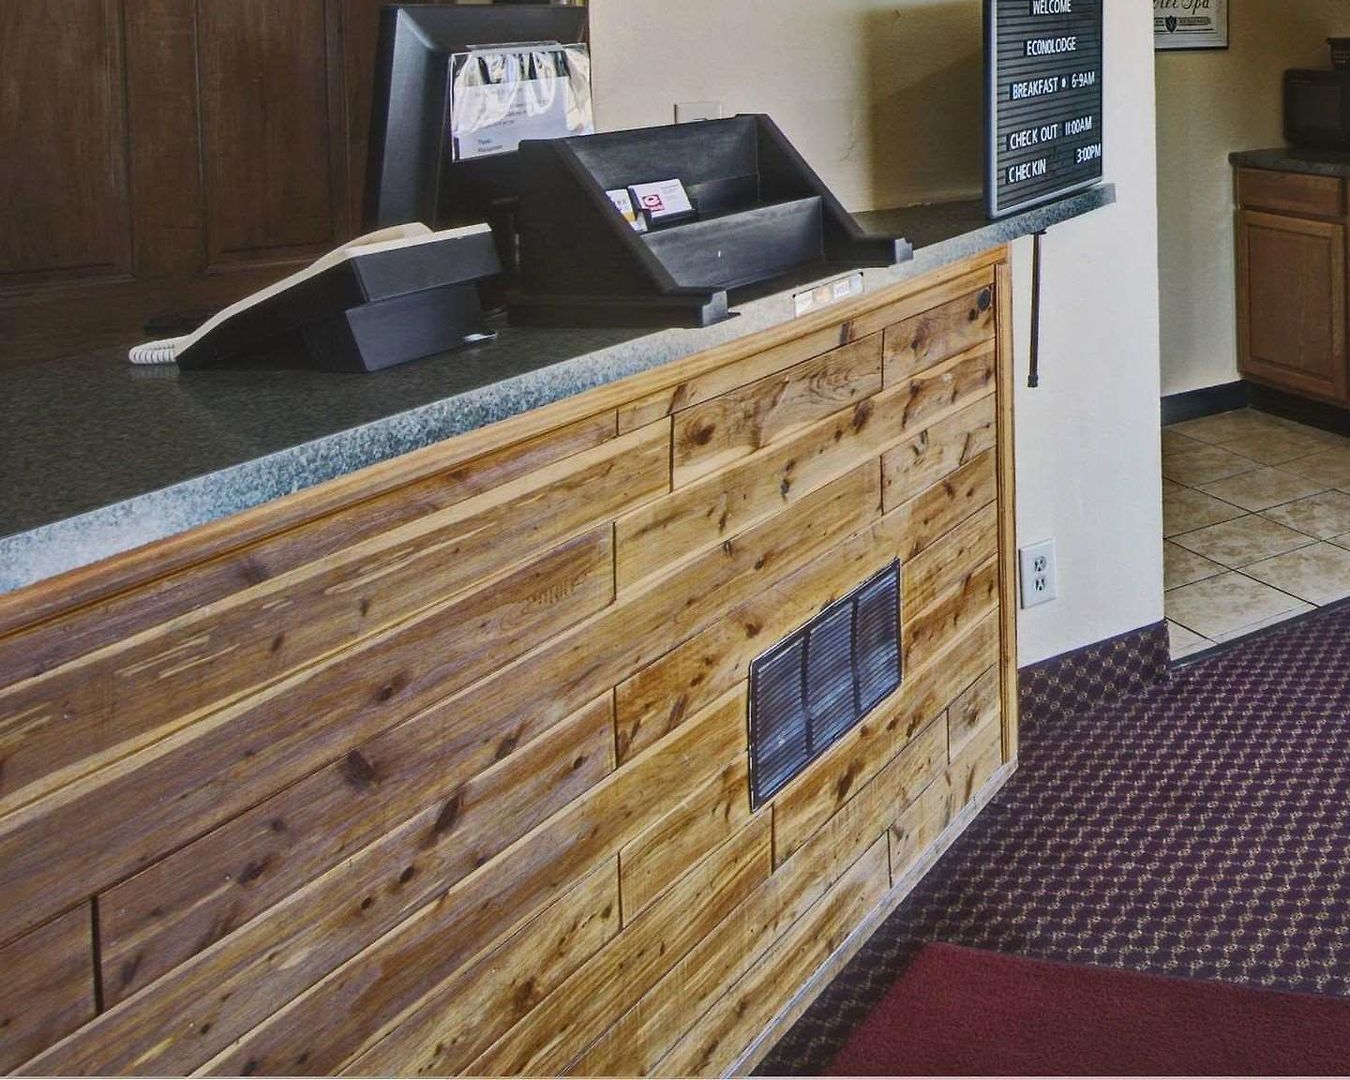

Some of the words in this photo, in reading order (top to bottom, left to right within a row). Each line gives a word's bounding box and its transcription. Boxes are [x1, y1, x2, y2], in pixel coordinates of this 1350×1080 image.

[1026, 36, 1077, 56] ECONOLODGE
[1012, 77, 1059, 100] BREAKFAST
[1071, 71, 1095, 89] 6-9AM
[1009, 127, 1038, 150] CHECK
[1040, 123, 1058, 142] OUT
[1076, 143, 1102, 164] 3:00PM
